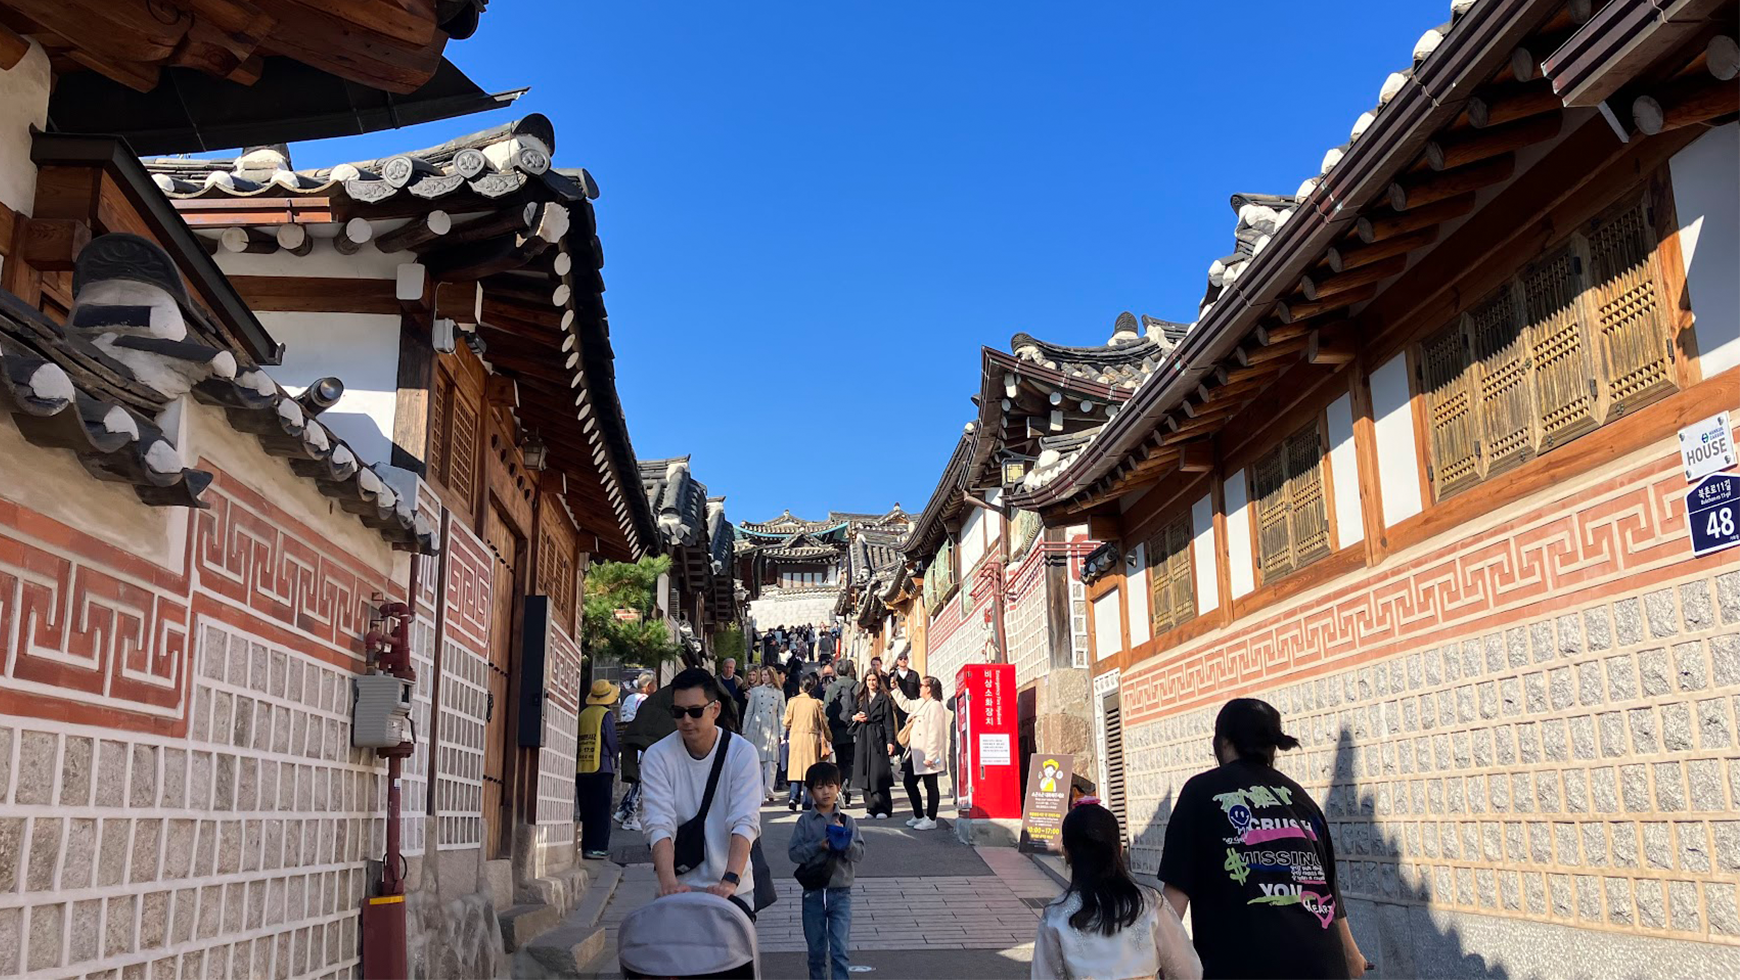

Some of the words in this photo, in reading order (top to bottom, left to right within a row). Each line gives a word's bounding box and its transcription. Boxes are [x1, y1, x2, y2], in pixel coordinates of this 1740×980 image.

[1687, 438, 1727, 466] HOUSE
[1698, 479, 1731, 499] 북촌로11길
[1706, 507, 1735, 539] 48
[984, 670, 993, 726] 비상소화장치
[1249, 817, 1312, 831] CRUSH
[1259, 883, 1303, 897] YOU
